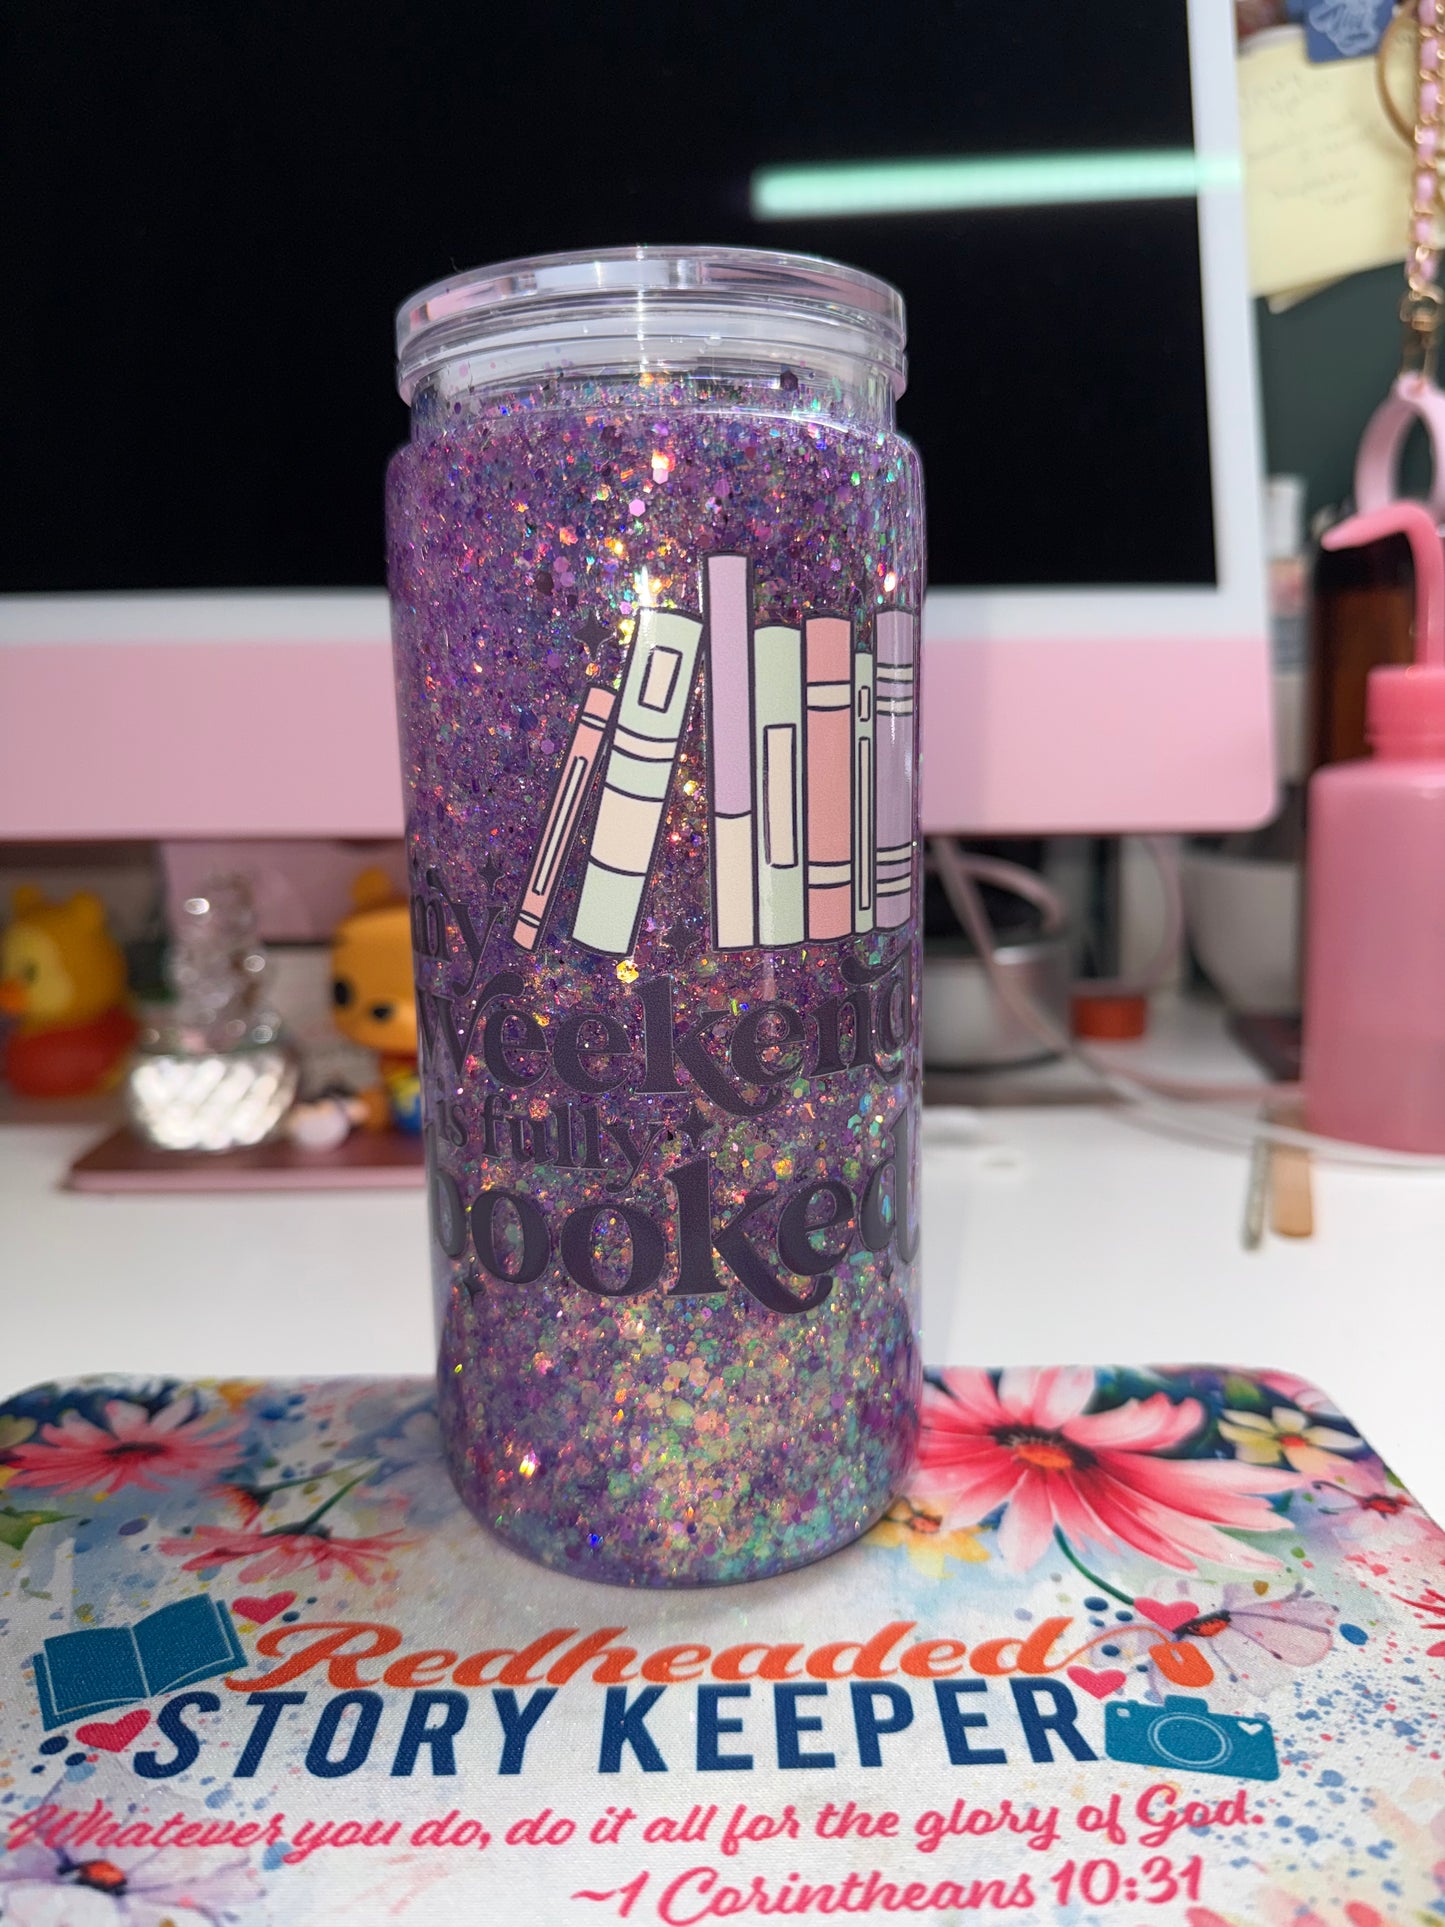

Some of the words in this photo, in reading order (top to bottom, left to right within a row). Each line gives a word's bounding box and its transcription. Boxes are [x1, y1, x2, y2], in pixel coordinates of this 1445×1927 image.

[410, 867, 506, 997] my
[480, 1093, 674, 1194] fully
[224, 1616, 1078, 1691] Redheaded
[133, 1687, 559, 1779] STORY
[598, 1675, 1100, 1775] KEEPER
[5, 1798, 285, 1851] Whatever
[281, 1819, 402, 1864] you
[409, 1809, 492, 1850] do,
[504, 1807, 577, 1846] do
[589, 1806, 637, 1844] it
[642, 1804, 719, 1843] all
[720, 1803, 801, 1857] for
[815, 1800, 900, 1839] the
[913, 1797, 1061, 1853] glory
[1075, 1793, 1127, 1845] of
[1134, 1783, 1265, 1848] God.
[656, 1865, 1037, 1927] Corintheans
[1050, 1854, 1203, 1906] 10:31
